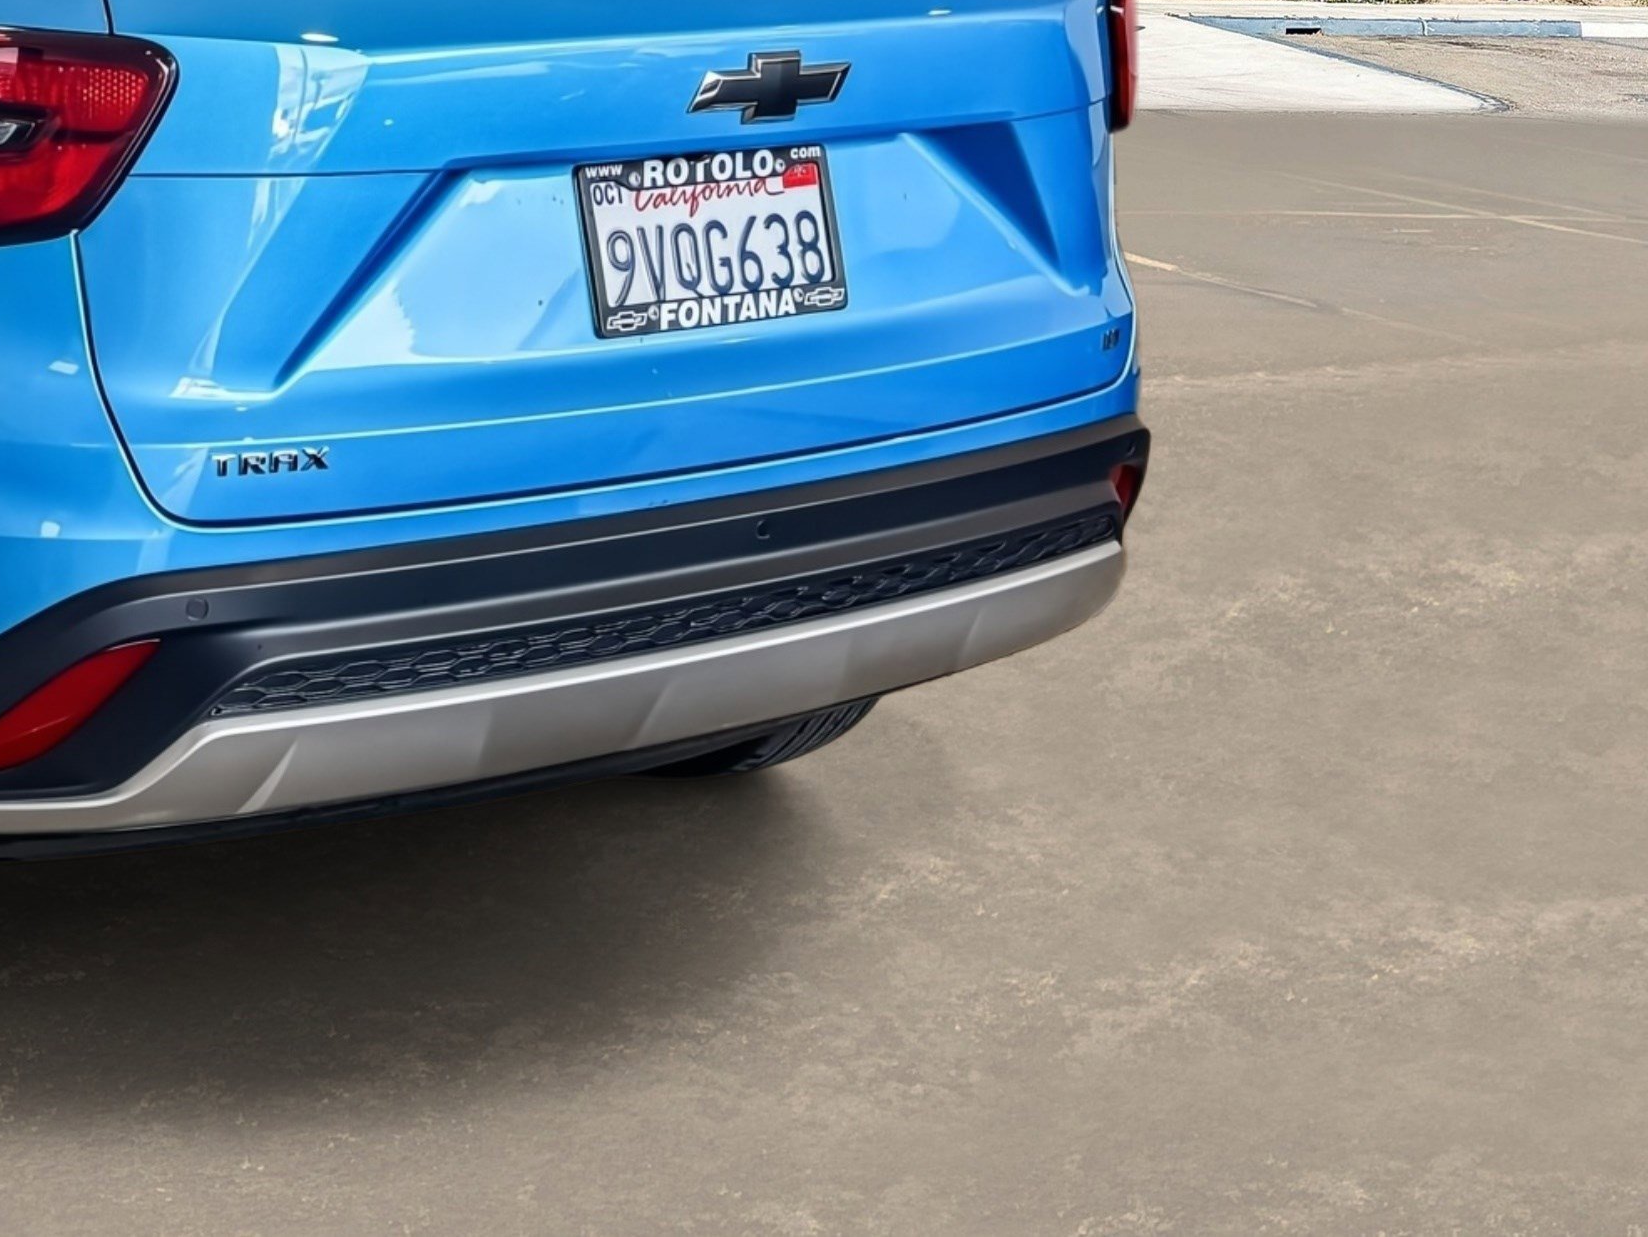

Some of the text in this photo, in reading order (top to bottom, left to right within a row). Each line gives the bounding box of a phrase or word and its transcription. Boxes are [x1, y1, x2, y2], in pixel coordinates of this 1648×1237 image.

[642, 149, 774, 189] ROTOLO
[606, 209, 826, 307] 9VQG638
[659, 288, 797, 331] FONTANA
[211, 446, 330, 477] TRAX
